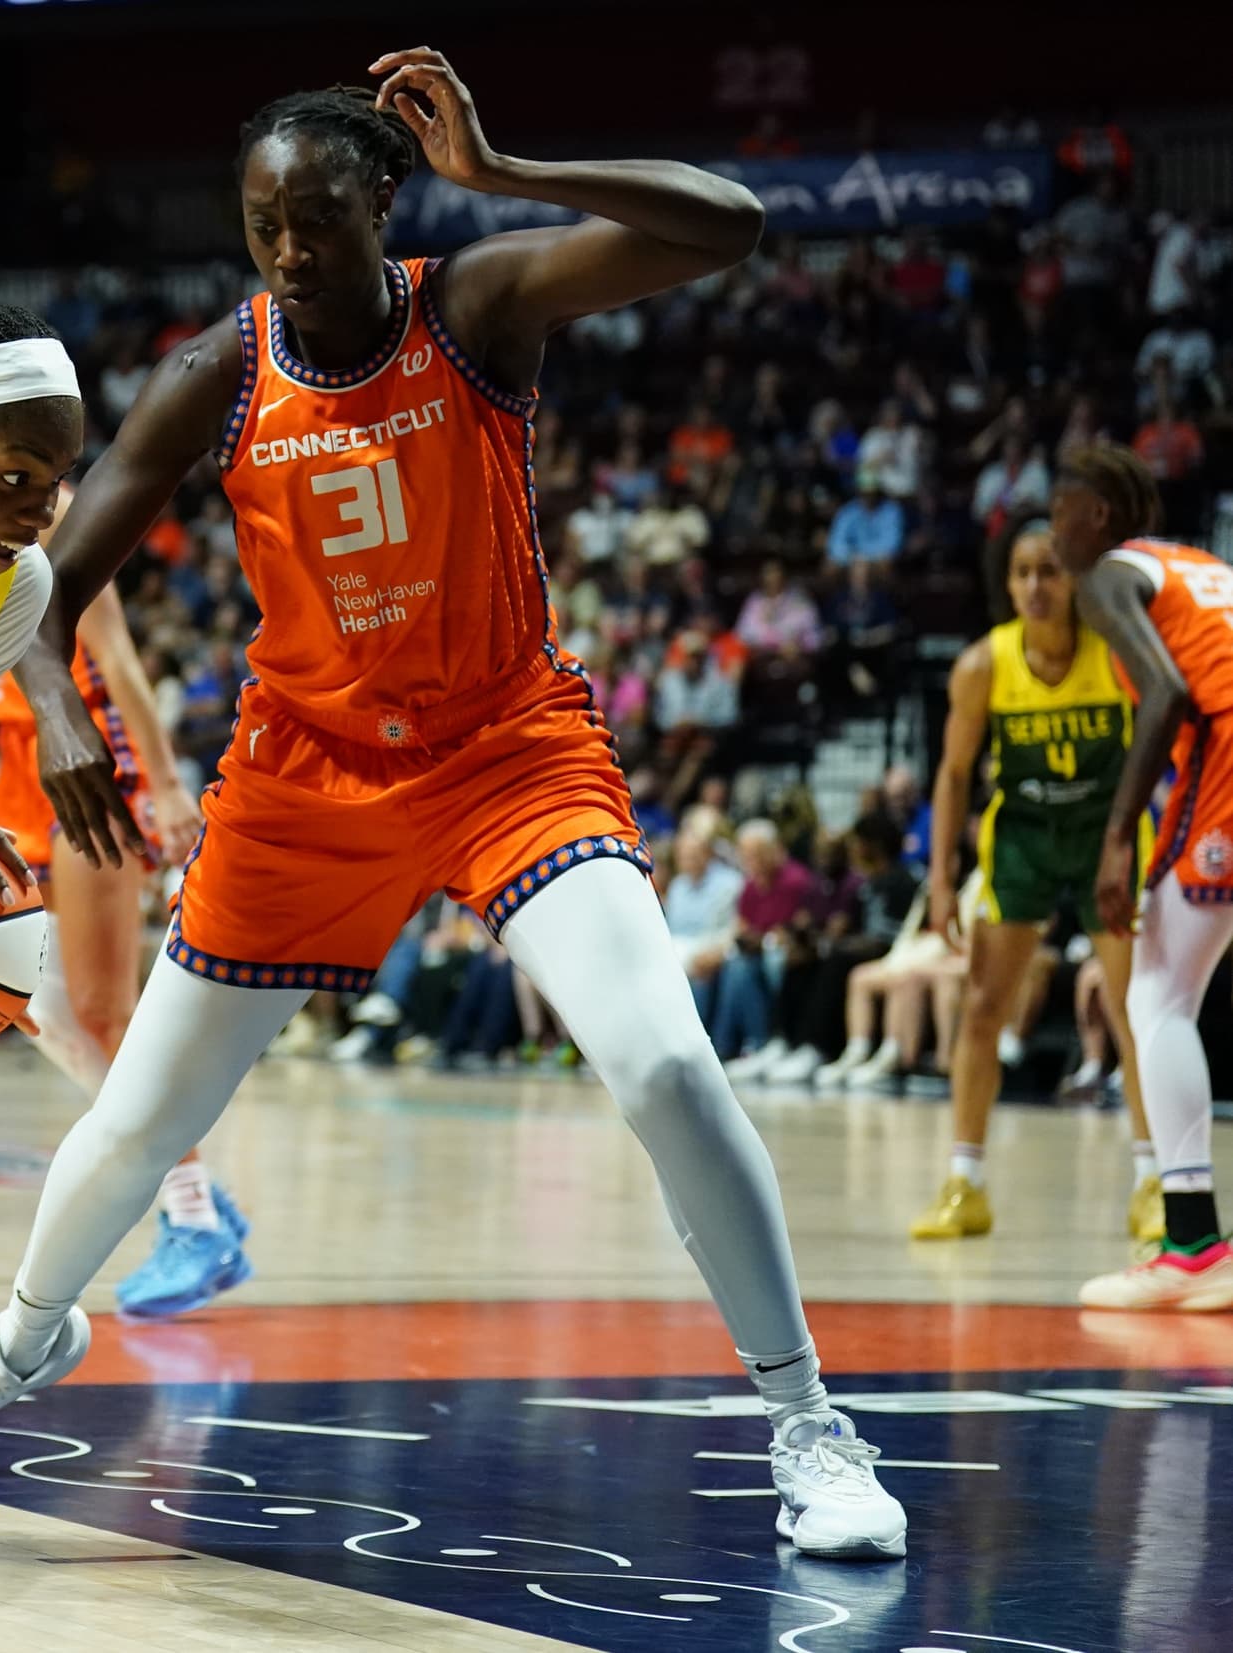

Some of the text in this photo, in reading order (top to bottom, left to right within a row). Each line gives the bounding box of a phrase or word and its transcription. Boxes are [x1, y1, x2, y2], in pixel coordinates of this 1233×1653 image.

[827, 152, 1032, 225] Arena
[251, 399, 445, 467] CONNECTICUT
[311, 458, 409, 557] 31
[327, 571, 367, 592] Yale
[339, 604, 406, 634] Health
[1004, 709, 1111, 745] SEATTLE
[1046, 742, 1077, 779] 4
